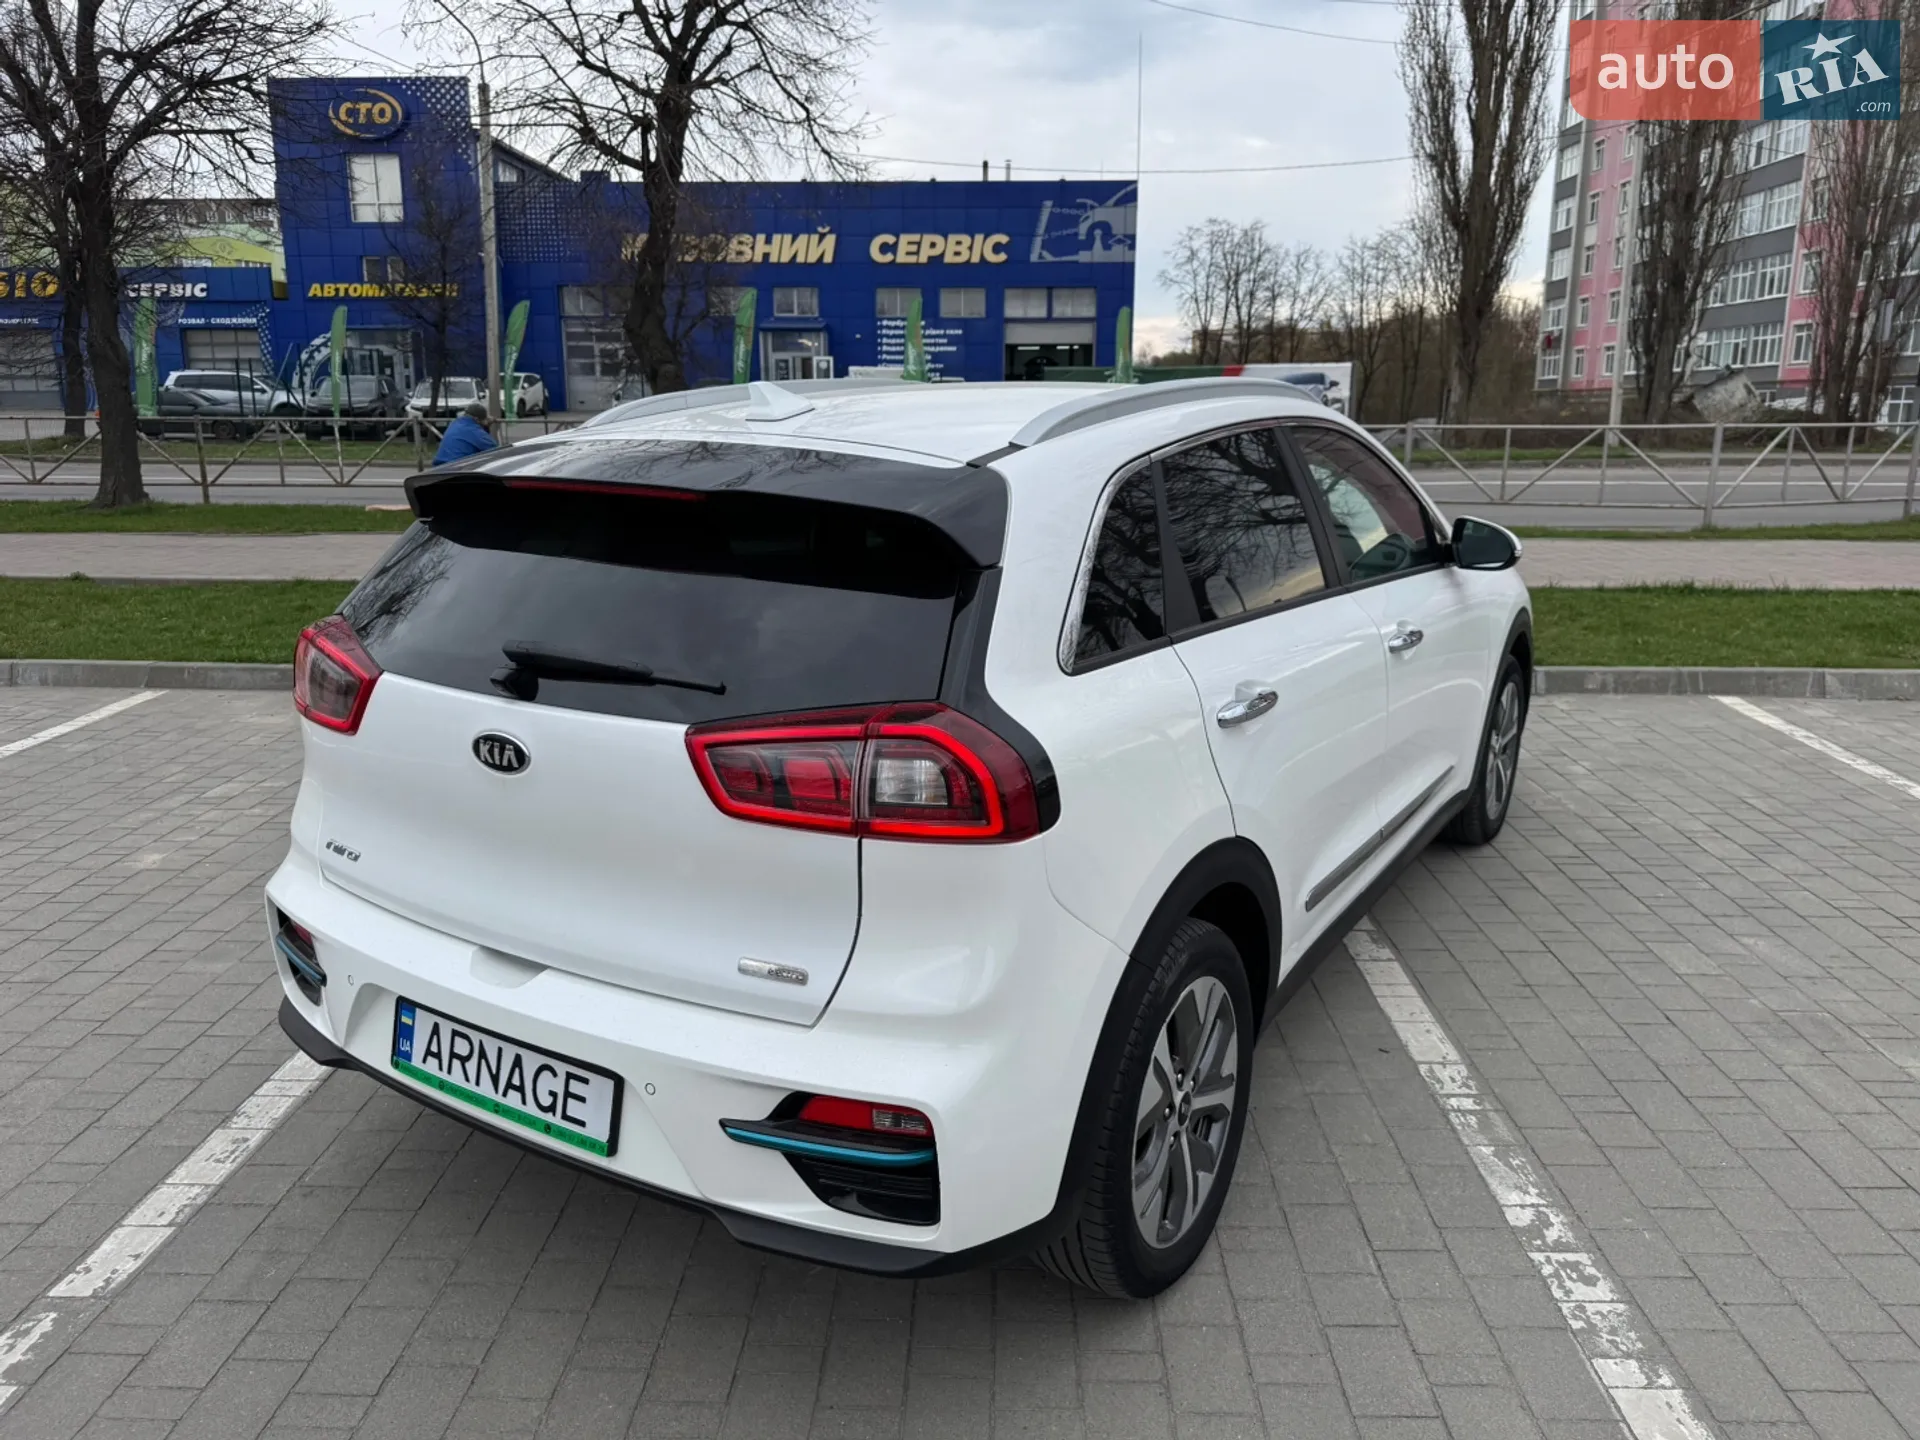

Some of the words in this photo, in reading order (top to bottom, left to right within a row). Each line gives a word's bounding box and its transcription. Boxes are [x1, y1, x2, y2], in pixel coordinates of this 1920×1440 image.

[338, 101, 393, 125] СТО
[620, 226, 837, 263] КЗОВНИЙ
[868, 233, 1010, 264] СЕРВІС
[125, 282, 208, 298] СЕРВІС
[478, 738, 520, 769] KIA
[399, 1037, 412, 1055] UA
[421, 1020, 590, 1129] ARNAGE
